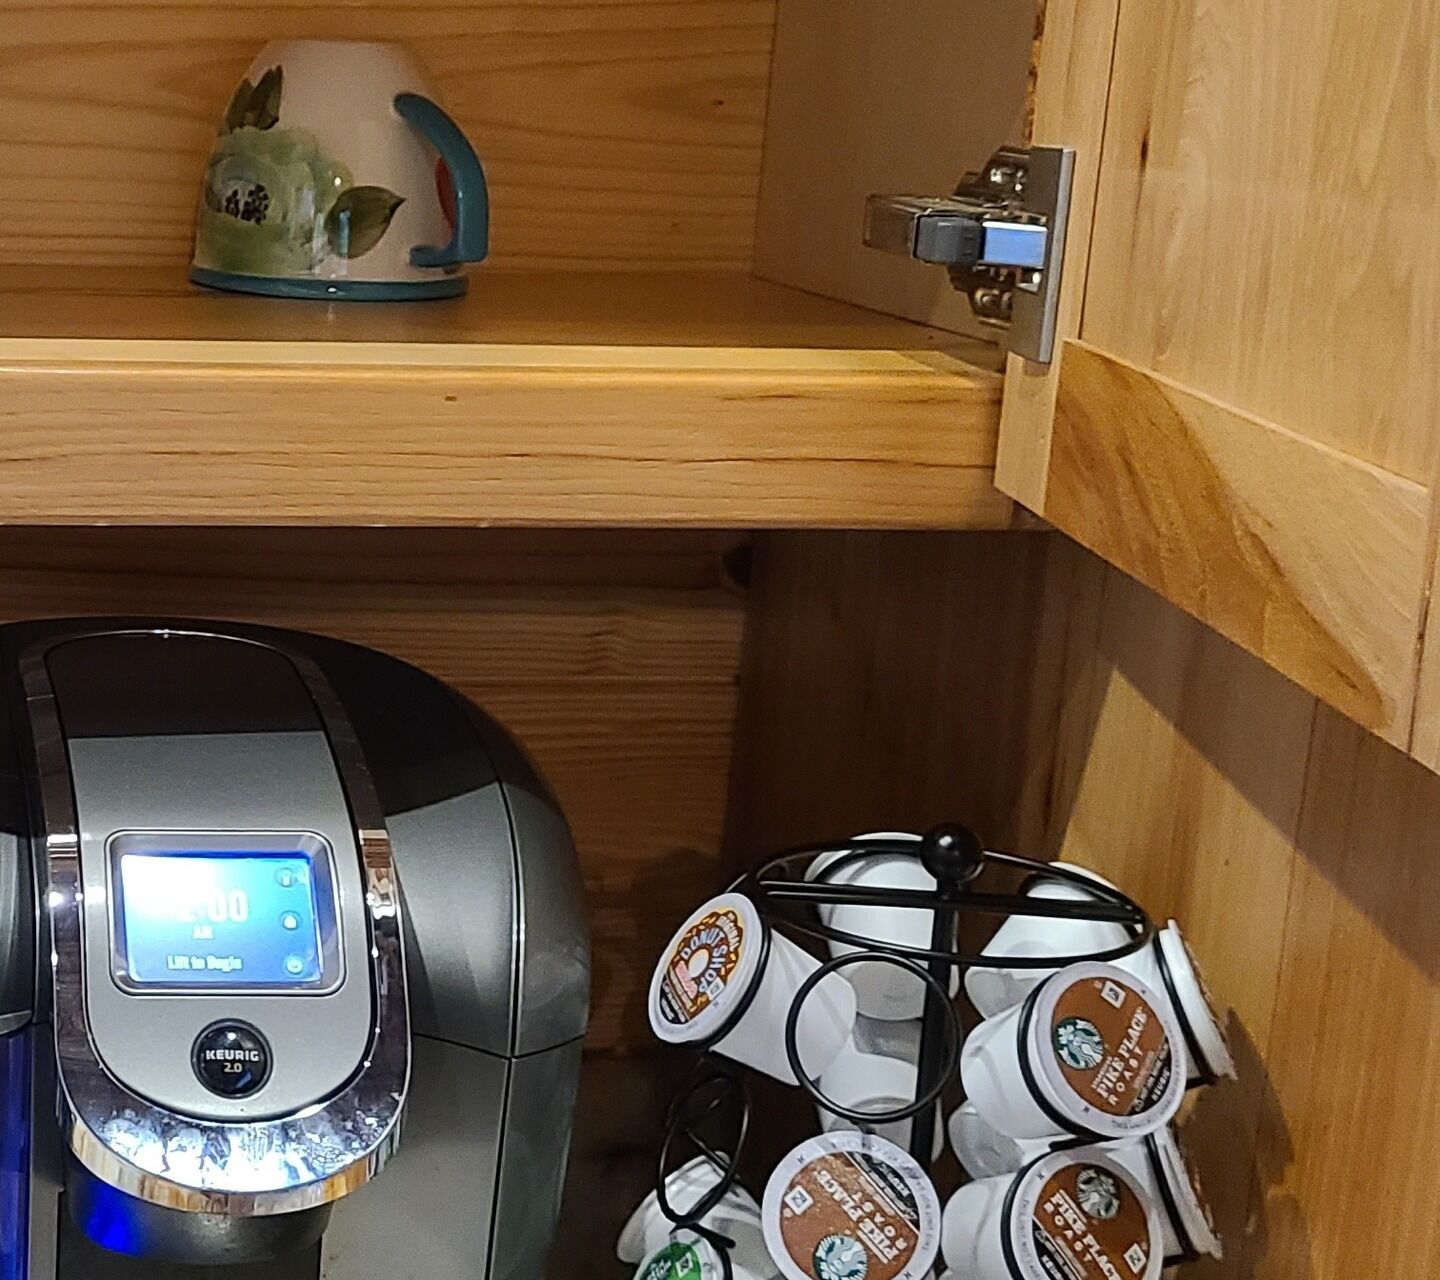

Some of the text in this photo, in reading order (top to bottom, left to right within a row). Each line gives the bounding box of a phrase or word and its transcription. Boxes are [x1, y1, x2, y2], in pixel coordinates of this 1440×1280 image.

[679, 926, 726, 960] DONUT
[698, 944, 729, 993] SHOP
[205, 1048, 259, 1062] KEURIG
[223, 1061, 243, 1073] 2.0
[1096, 1008, 1148, 1099] PIKE PLACE
[1108, 1045, 1143, 1107] ROAST
[1049, 1191, 1088, 1236] PIKE
[858, 1217, 900, 1261] PIKE
